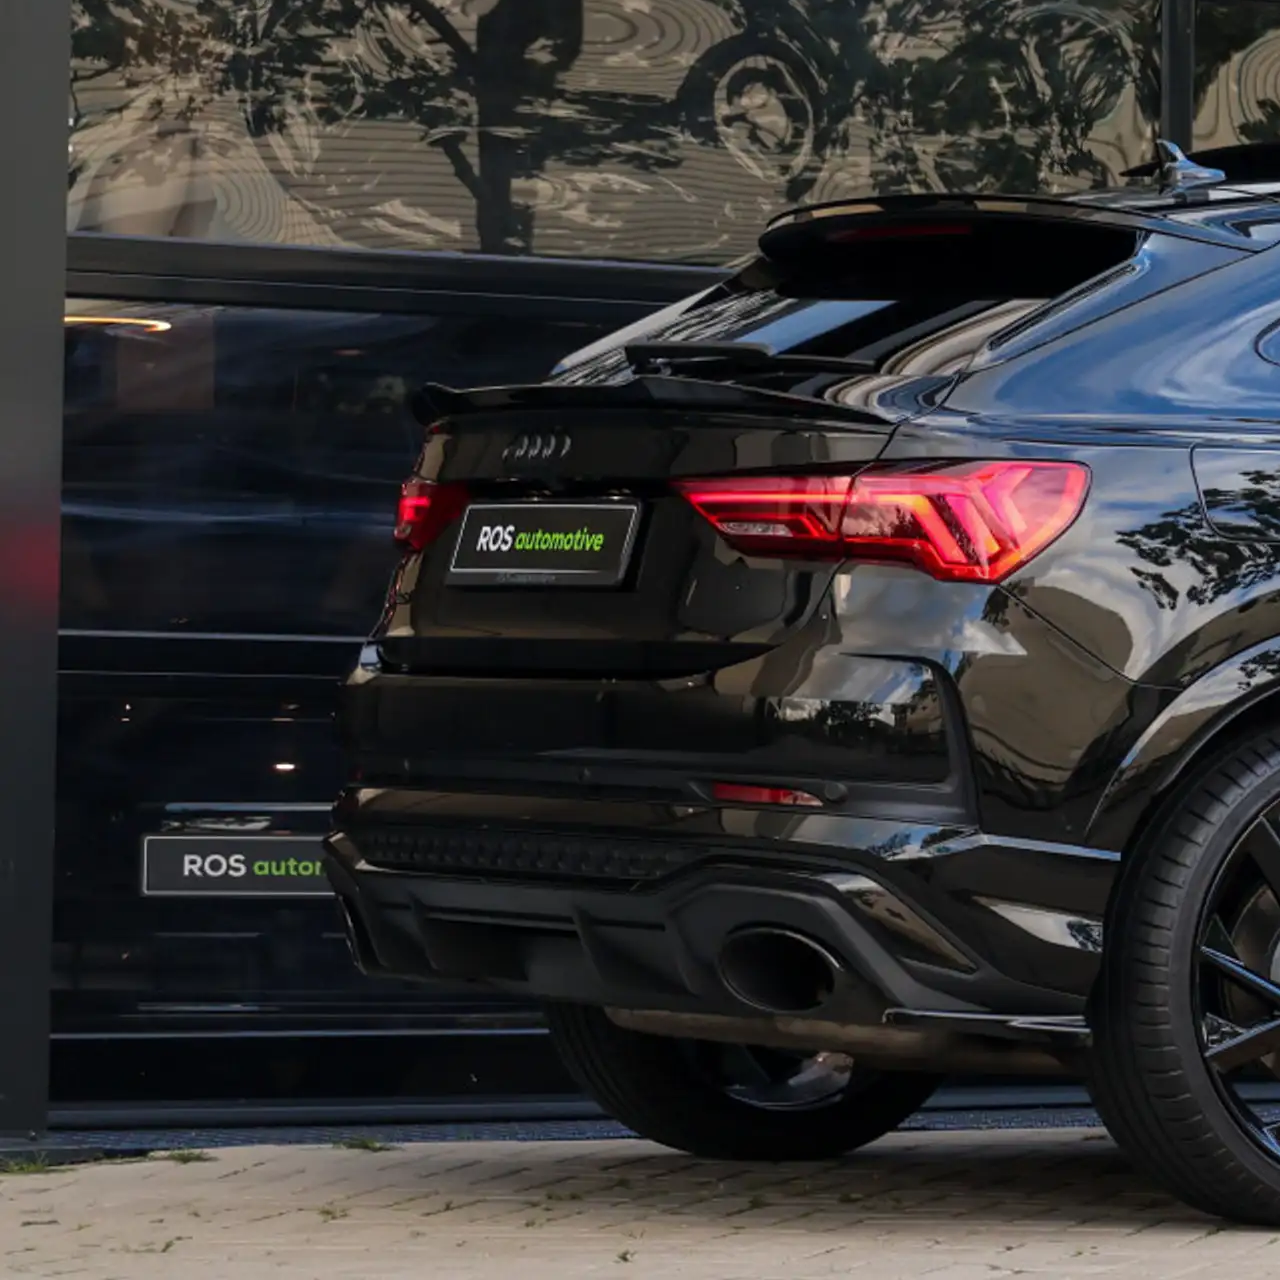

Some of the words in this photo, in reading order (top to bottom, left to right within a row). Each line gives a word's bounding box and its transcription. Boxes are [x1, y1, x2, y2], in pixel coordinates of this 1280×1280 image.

[476, 524, 515, 552] ROS
[514, 526, 604, 552] automotive
[182, 854, 247, 877] ROS
